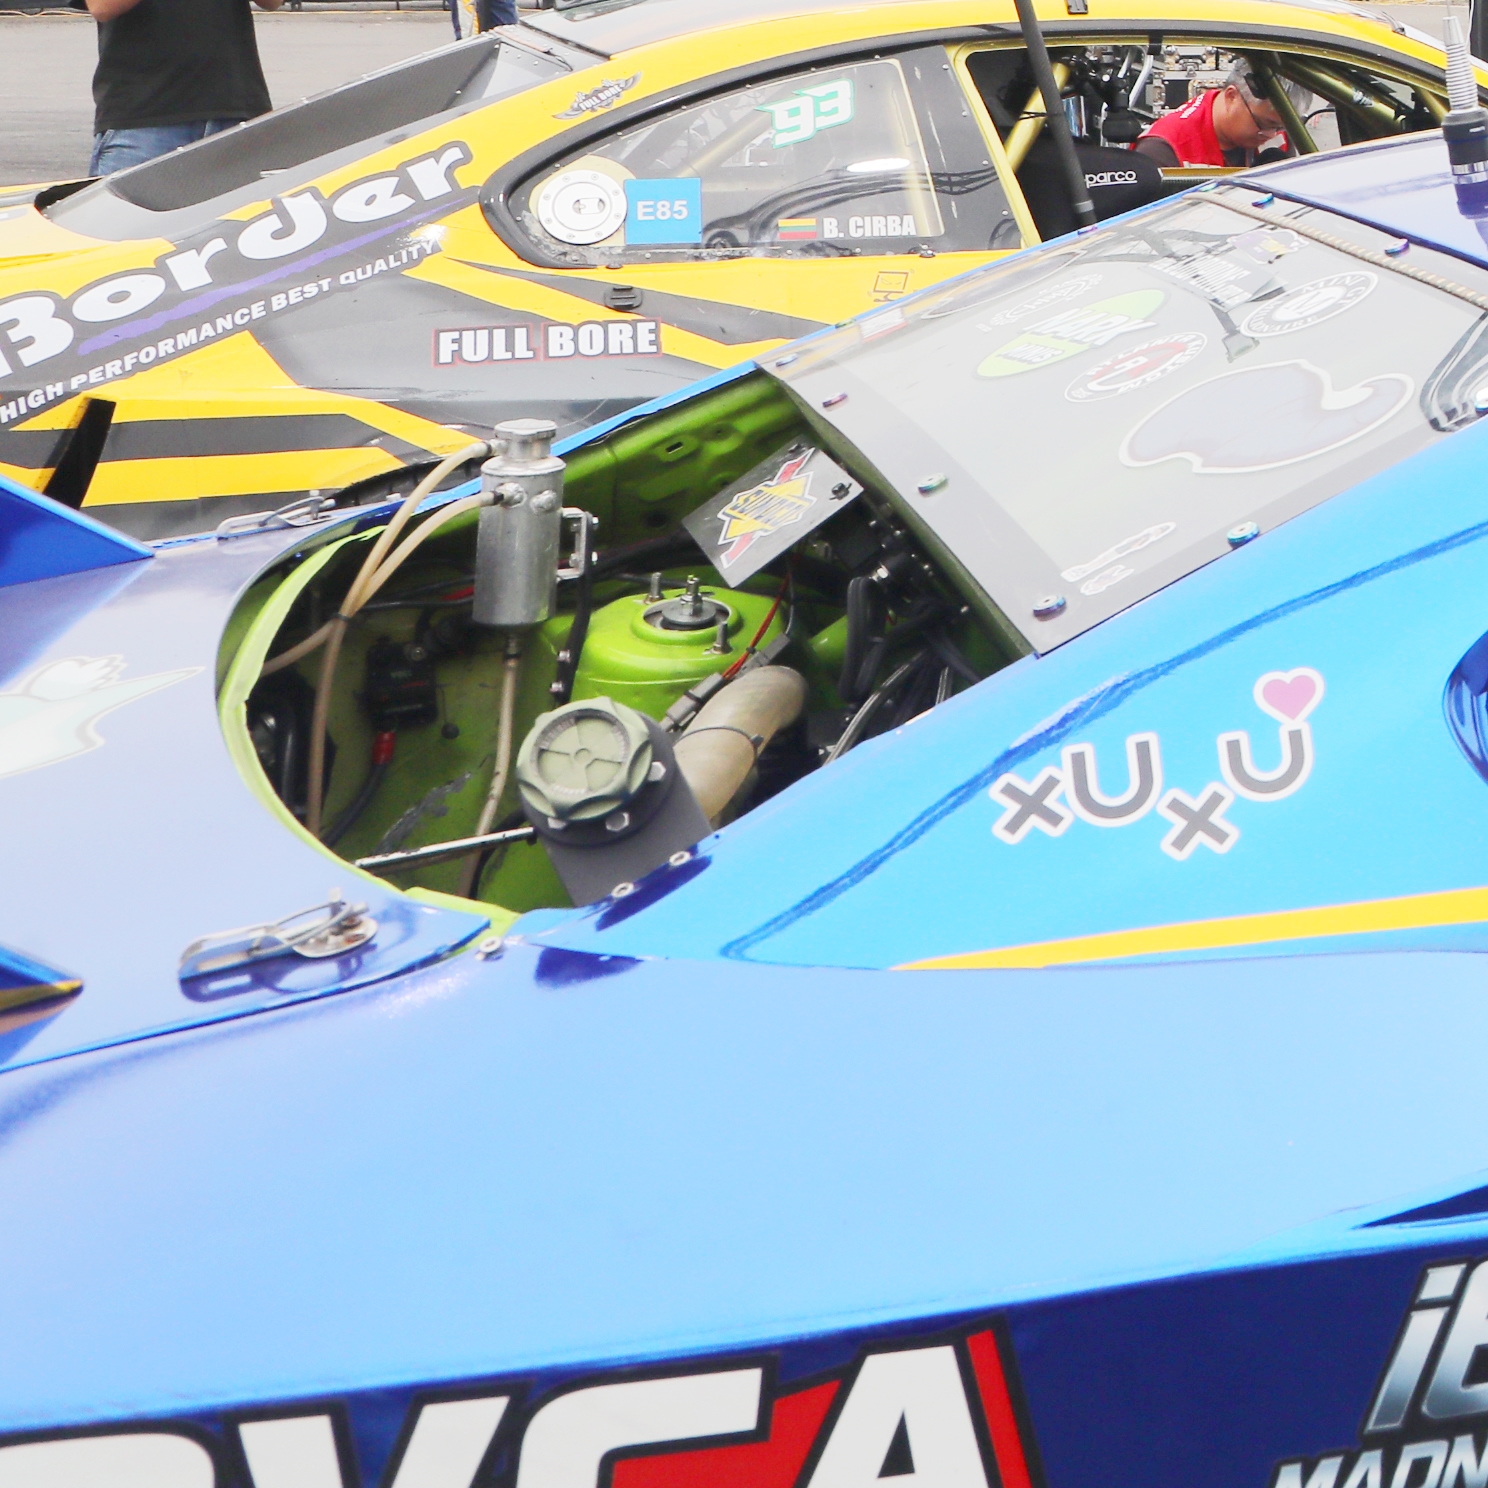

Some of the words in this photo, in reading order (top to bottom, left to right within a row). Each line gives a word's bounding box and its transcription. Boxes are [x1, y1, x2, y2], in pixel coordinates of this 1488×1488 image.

[756, 78, 854, 148] 93
[1084, 169, 1138, 188] parco
[636, 199, 689, 222] E85
[822, 217, 845, 239] B.
[848, 214, 918, 237] CIRBA
[0, 381, 64, 424] HIGH
[70, 299, 267, 390] PERFORMANCE
[270, 277, 332, 314] BEST
[338, 238, 437, 286] QUALITY
[437, 326, 536, 366] FULL
[547, 320, 660, 359] BORE
